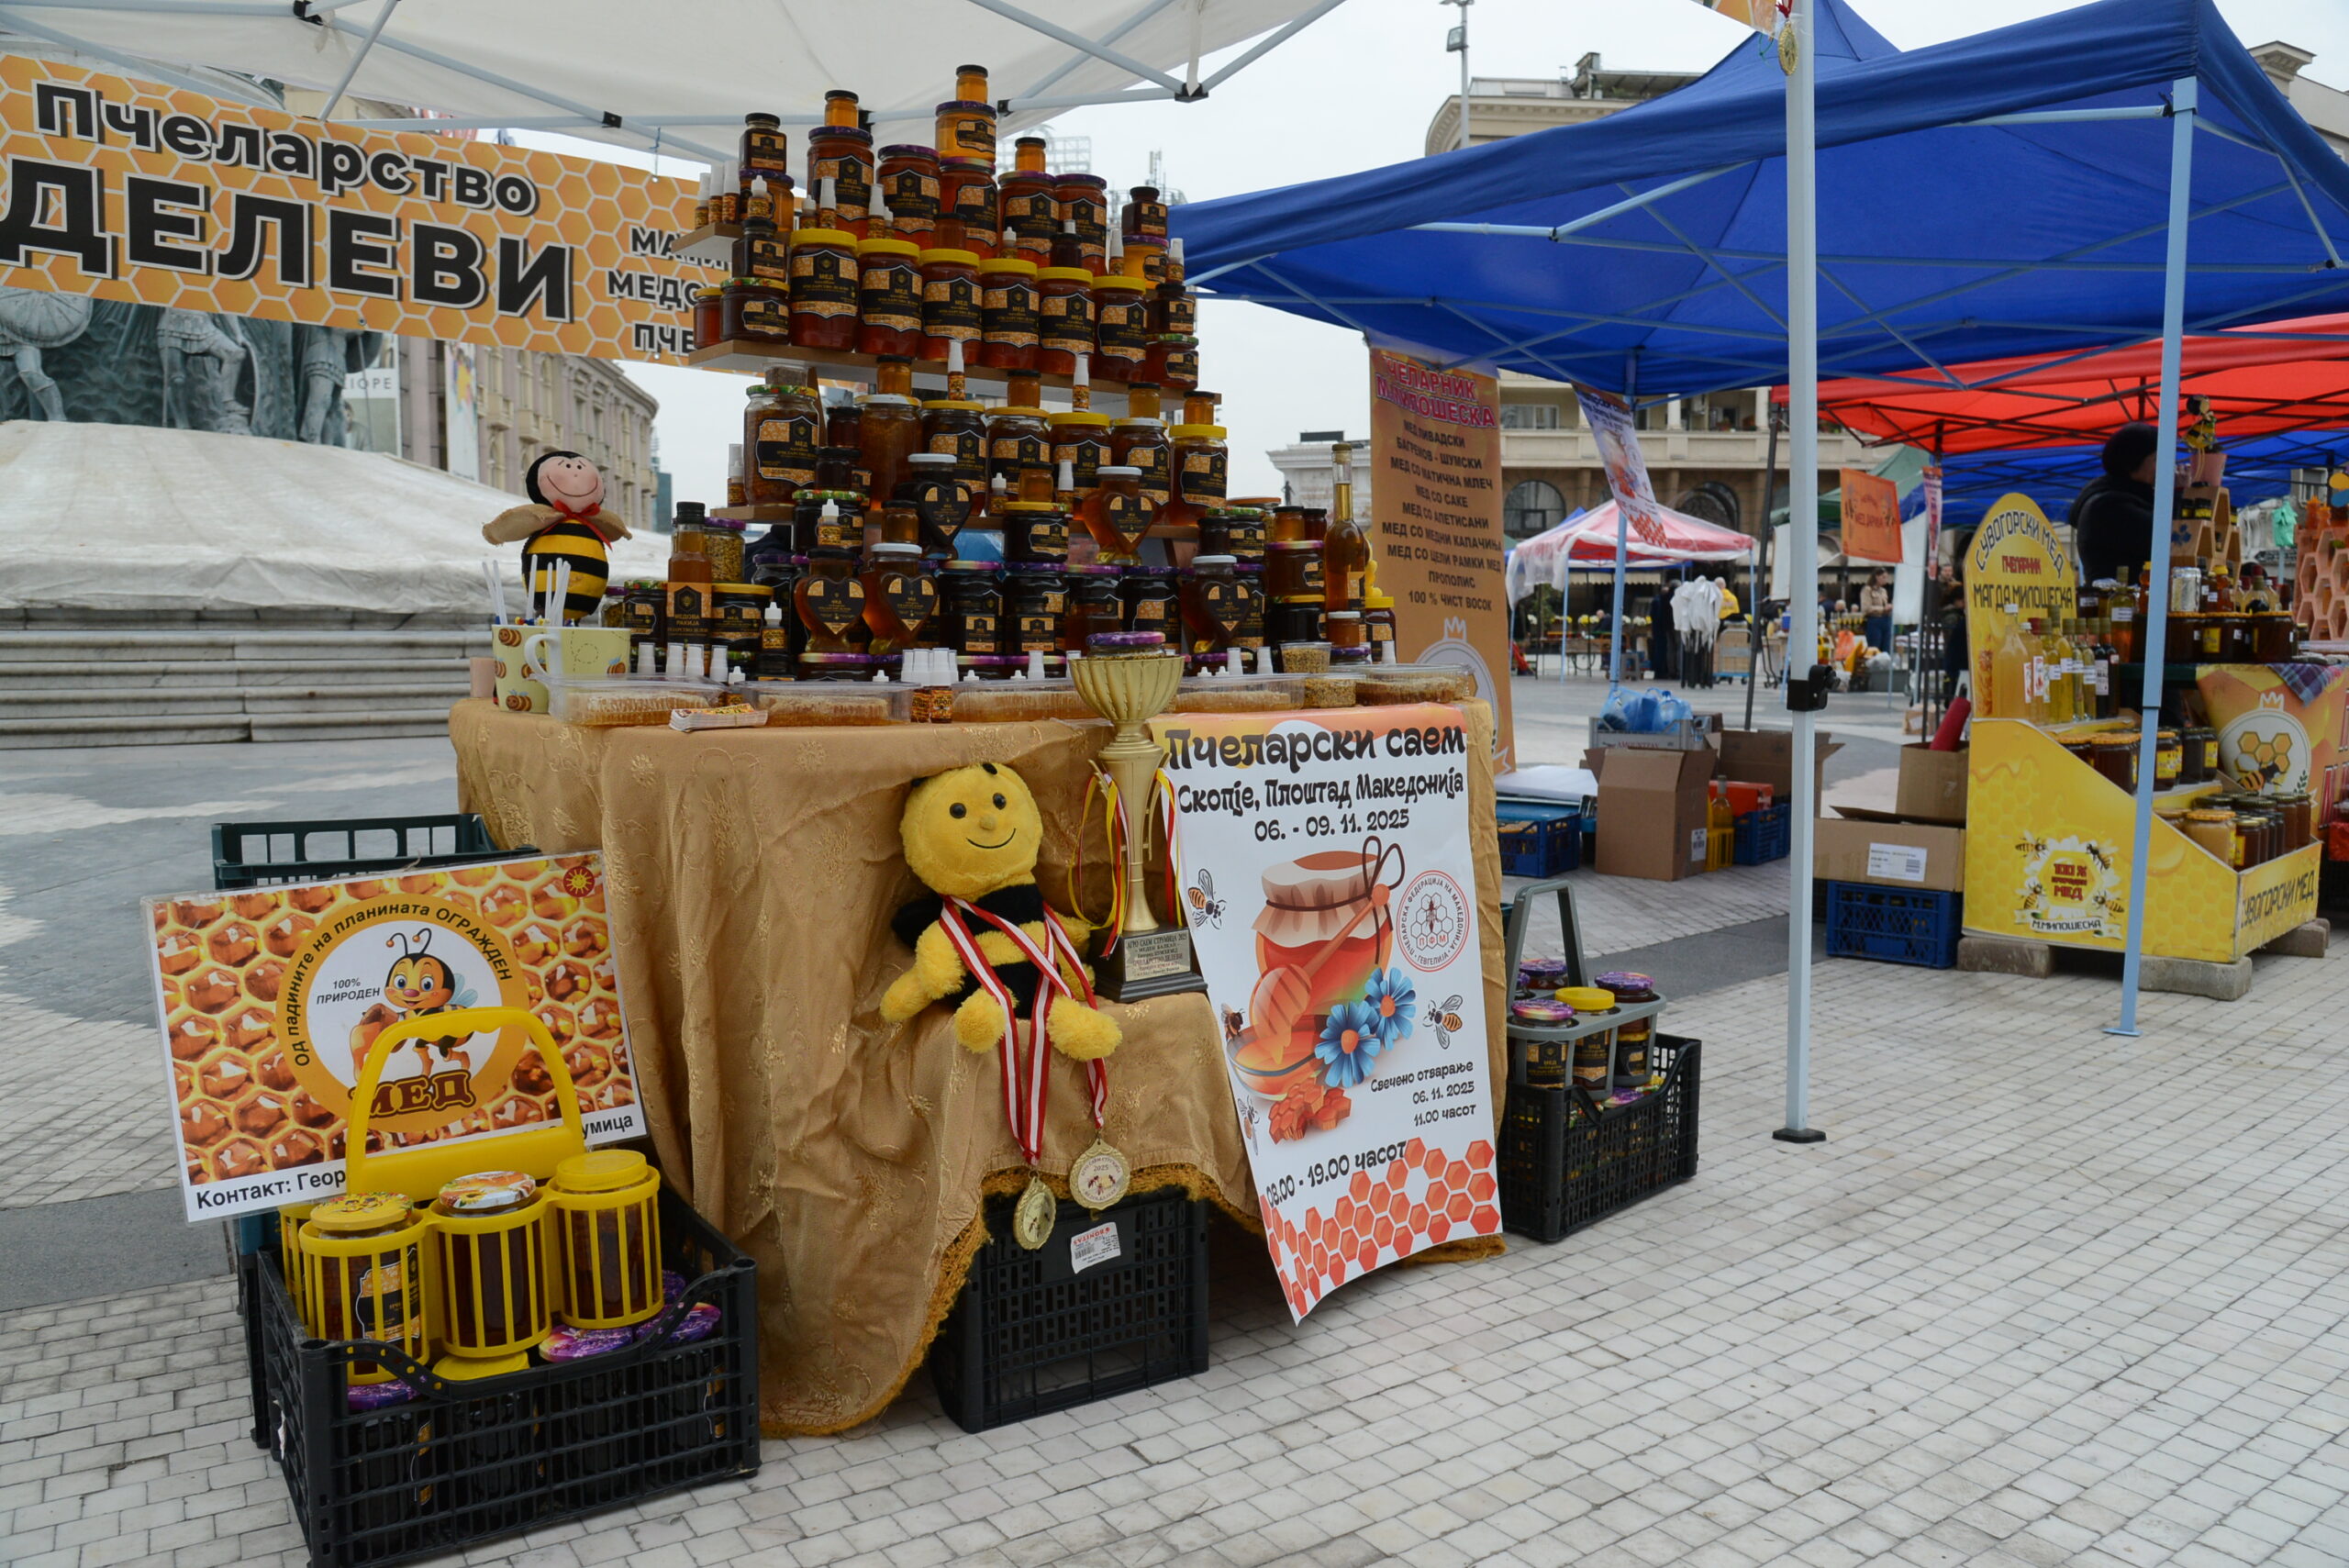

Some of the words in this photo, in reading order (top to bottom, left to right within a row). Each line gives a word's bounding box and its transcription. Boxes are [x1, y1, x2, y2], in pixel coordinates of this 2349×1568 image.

[33, 80, 538, 216] Пчеларство
[0, 154, 573, 323] ДЕЛЕВИ
[634, 323, 695, 355] ПЧЕ
[343, 377, 393, 390] IOPE
[1382, 355, 1478, 402] ЧЕЛАРНИК
[1390, 457, 1410, 473] МЕД
[1421, 468, 1462, 487] МАТИЧНА
[1464, 476, 1493, 490] МЛЕЧ
[1440, 452, 1482, 470] ШУМСКИ
[1431, 491, 1442, 503] СО
[1445, 494, 1468, 507] САКЕ
[1382, 522, 1407, 538] МЕД
[1409, 525, 1424, 538] СО
[1402, 502, 1422, 517] МЕД
[1424, 509, 1432, 520] СО
[1434, 511, 1489, 529] АПЕТИСАНИ
[1387, 545, 1412, 560] МЕД
[1415, 548, 1428, 560] СО
[1453, 555, 1485, 569] РАМКИ
[1487, 559, 1501, 573] МЕД
[1429, 571, 1475, 588] ПРОПОЛИС
[1409, 591, 1427, 604] 100
[1441, 595, 1464, 607] ЧИСТ
[1466, 597, 1492, 611] ВОСОК
[1165, 728, 1377, 773] Пчеларски
[1386, 726, 1466, 758] саем
[1178, 780, 1261, 817] Скопје,
[1264, 779, 1353, 809] Плоштад
[1356, 767, 1464, 805] Македонија
[1254, 819, 1286, 842] 06.
[1306, 816, 1336, 837] 09.
[1341, 813, 1362, 834] 11.
[1366, 808, 1410, 832] 2025
[1401, 906, 1415, 956] ПЧЕЛАРСКА
[1408, 877, 1443, 903] ФЕДЕРАЦИЈА
[1450, 894, 1464, 951] МАКЕДОНИЈА
[286, 953, 315, 1037] падините
[313, 932, 333, 953] на
[333, 903, 430, 935] планината
[436, 907, 513, 981] ОГРАЖДЕН
[1417, 951, 1449, 965] ГЕВГЕЛИЈА
[317, 987, 381, 1006] ПРИРОДЕН
[333, 978, 361, 990] 100%
[1371, 1073, 1415, 1093] Свечено
[1417, 1061, 1474, 1082] отварање
[1412, 1092, 1429, 1105] 06.
[1431, 1087, 1444, 1100] 11.
[1446, 1081, 1475, 1097] 2025
[1414, 1110, 1439, 1127] 11.00
[1442, 1104, 1476, 1120] часот
[196, 1179, 292, 1210] Контакт:
[297, 1168, 347, 1195] Геор
[582, 1114, 633, 1140] умица
[1266, 1174, 1296, 1207] 08.00
[1308, 1155, 1350, 1187] 19.00
[1355, 1140, 1407, 1170] часот
